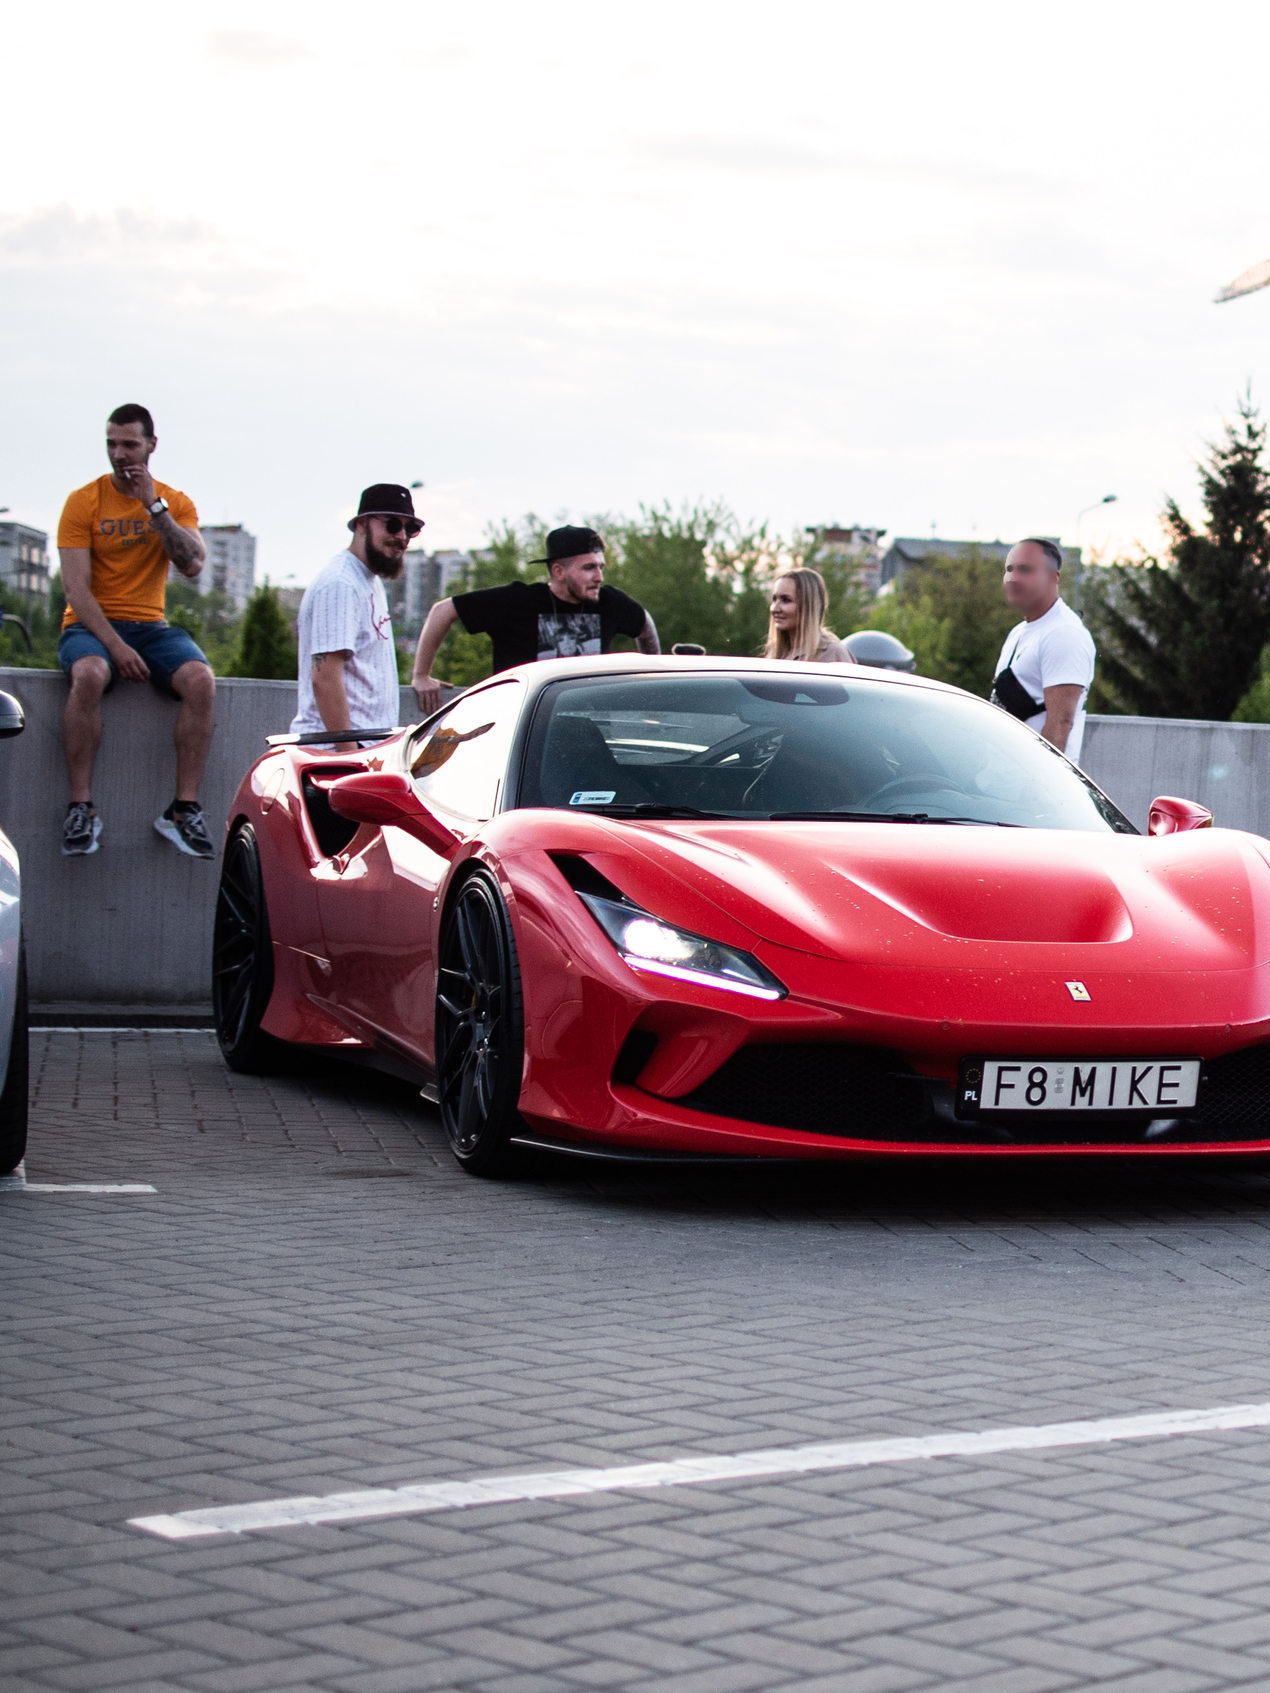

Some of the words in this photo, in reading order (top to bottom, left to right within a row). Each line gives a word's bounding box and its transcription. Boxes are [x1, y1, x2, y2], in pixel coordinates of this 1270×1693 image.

[100, 518, 156, 536] GUES
[994, 1065, 1048, 1107] F8
[1070, 1065, 1182, 1107] MIKE
[964, 1090, 978, 1101] PL
